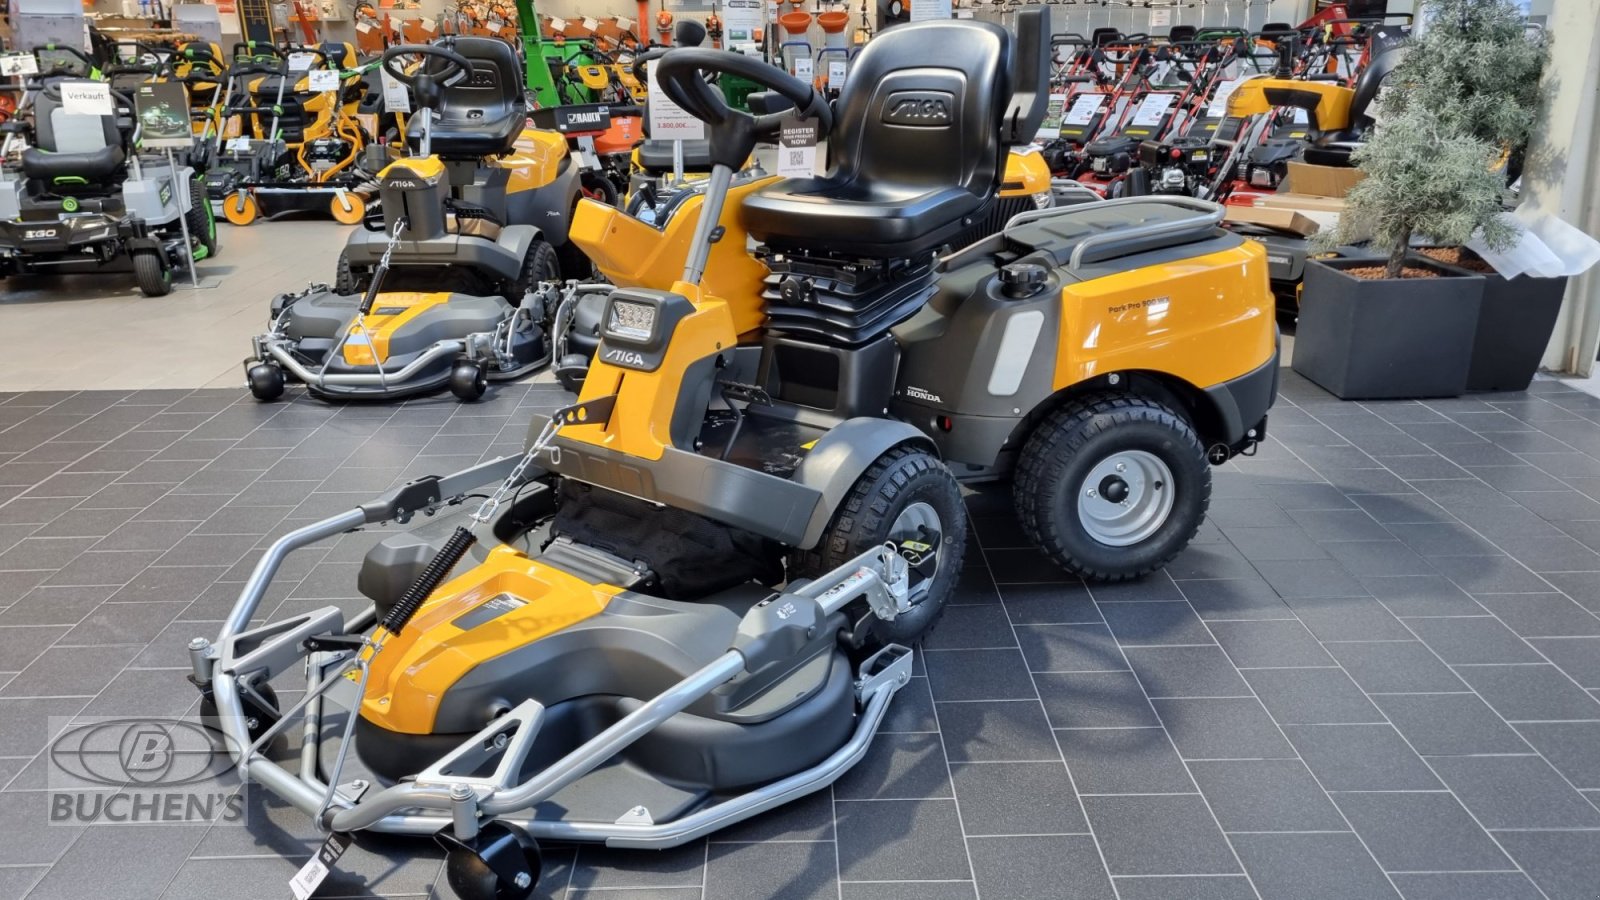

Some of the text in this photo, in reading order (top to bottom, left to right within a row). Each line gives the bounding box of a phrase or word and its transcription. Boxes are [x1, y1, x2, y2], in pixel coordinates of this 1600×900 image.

[67, 92, 105, 100] Verkauft
[890, 99, 947, 118] STIGA
[576, 112, 601, 123] RAUCH
[783, 127, 814, 135] REGISTER
[25, 229, 57, 239] EGO
[1108, 304, 1127, 313] Park
[1142, 298, 1157, 307] 900
[605, 350, 644, 365] STIGA
[907, 390, 943, 403] HONDA
